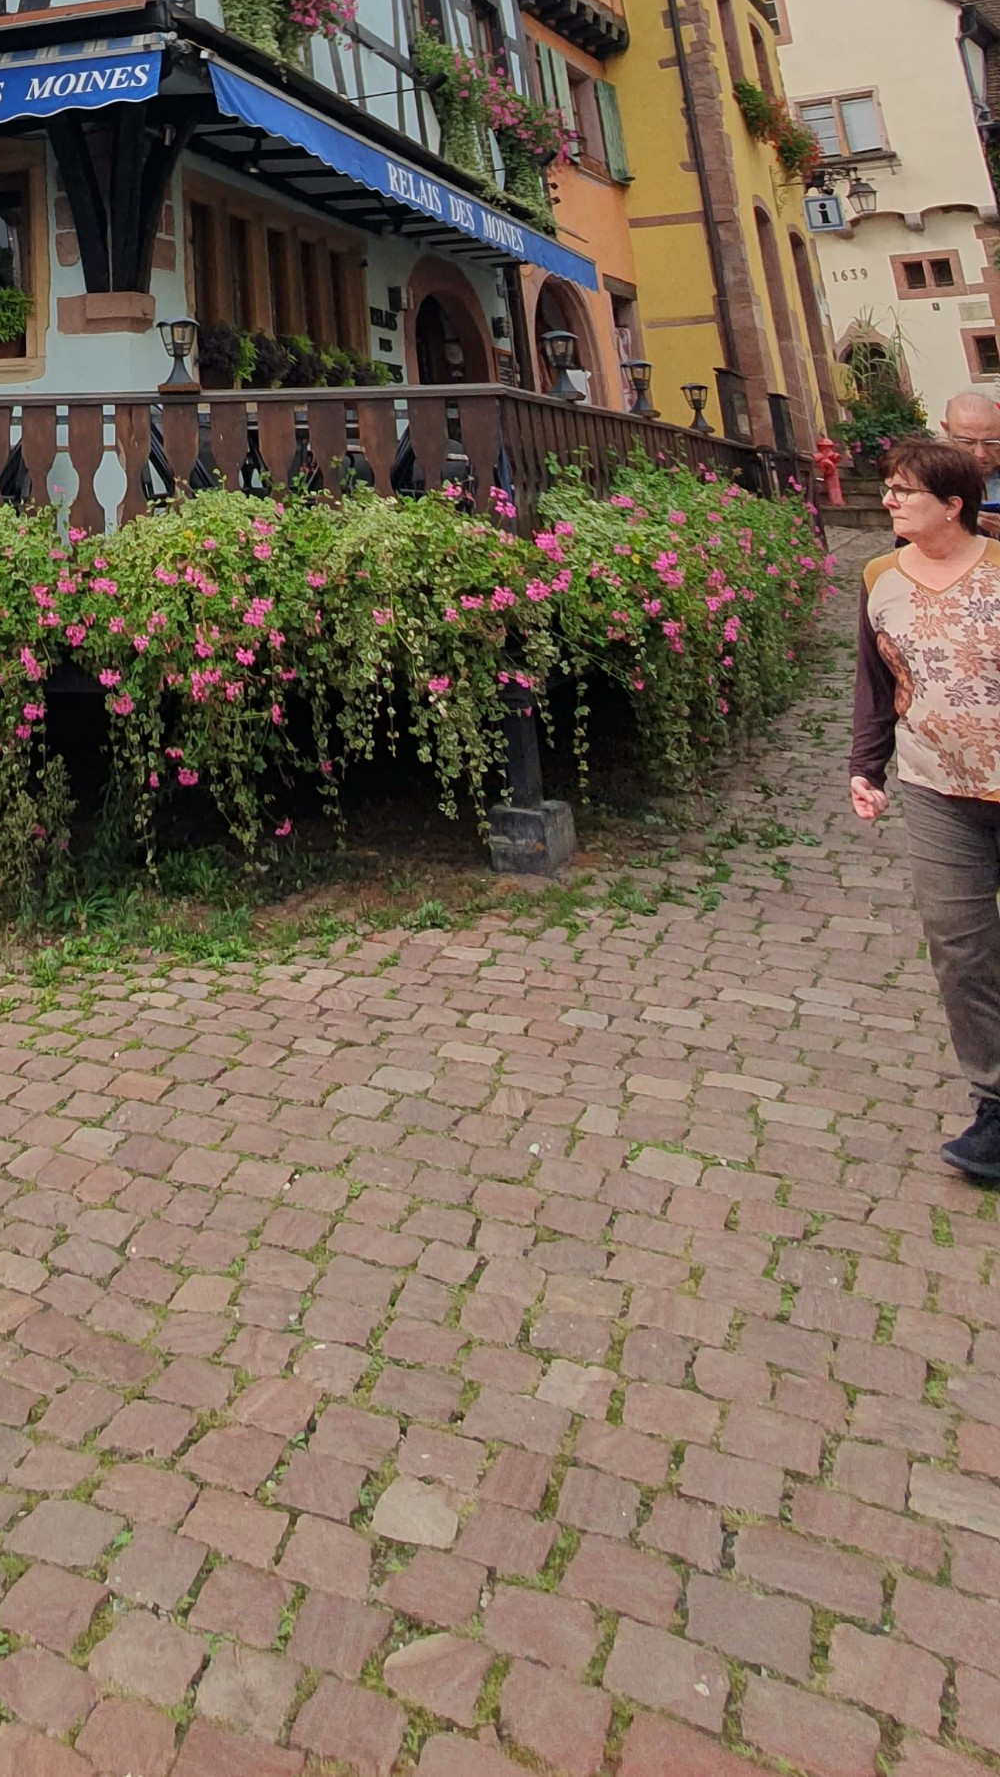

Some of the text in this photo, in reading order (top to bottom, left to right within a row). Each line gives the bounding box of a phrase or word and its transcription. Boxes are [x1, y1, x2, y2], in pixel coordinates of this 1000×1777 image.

[24, 64, 150, 101] MOINES
[386, 161, 525, 254] RELAIS DES MOINES
[832, 268, 868, 283] 1639
